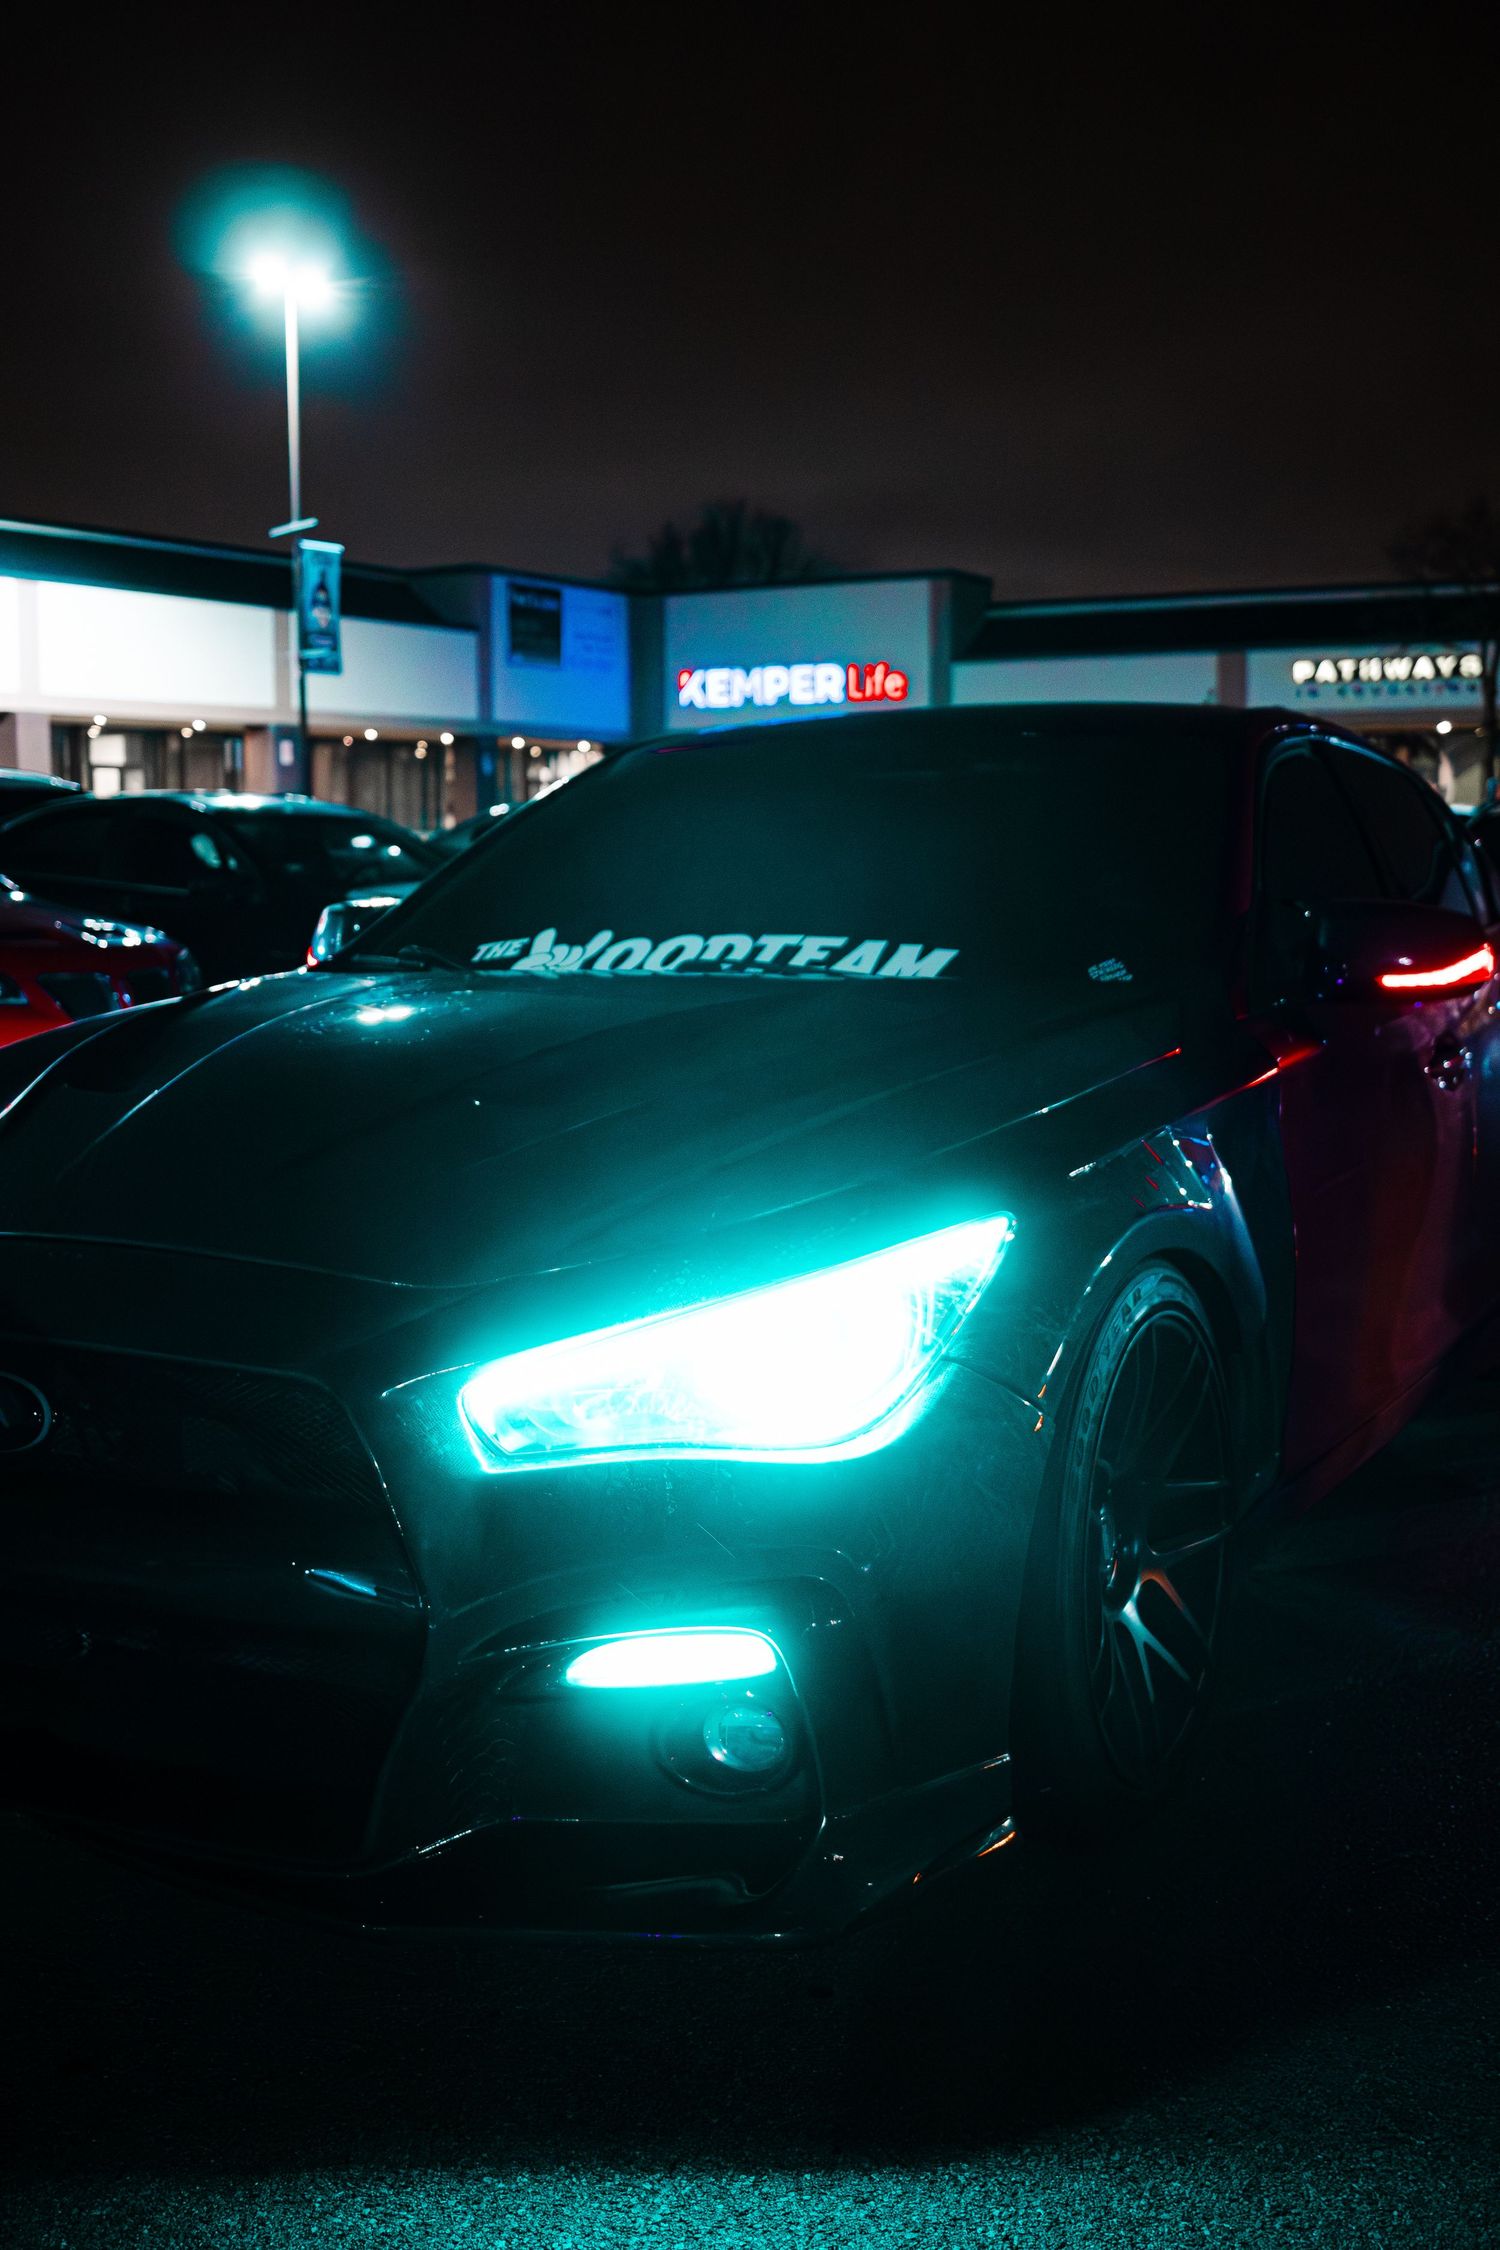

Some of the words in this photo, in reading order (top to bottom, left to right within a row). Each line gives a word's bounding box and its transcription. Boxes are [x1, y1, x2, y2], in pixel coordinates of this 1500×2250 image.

[679, 663, 846, 708] KEMPER
[846, 661, 908, 701] Life
[1292, 654, 1483, 684] PATHWAYS
[471, 937, 530, 963] THE
[510, 927, 960, 978] WOODTEAM
